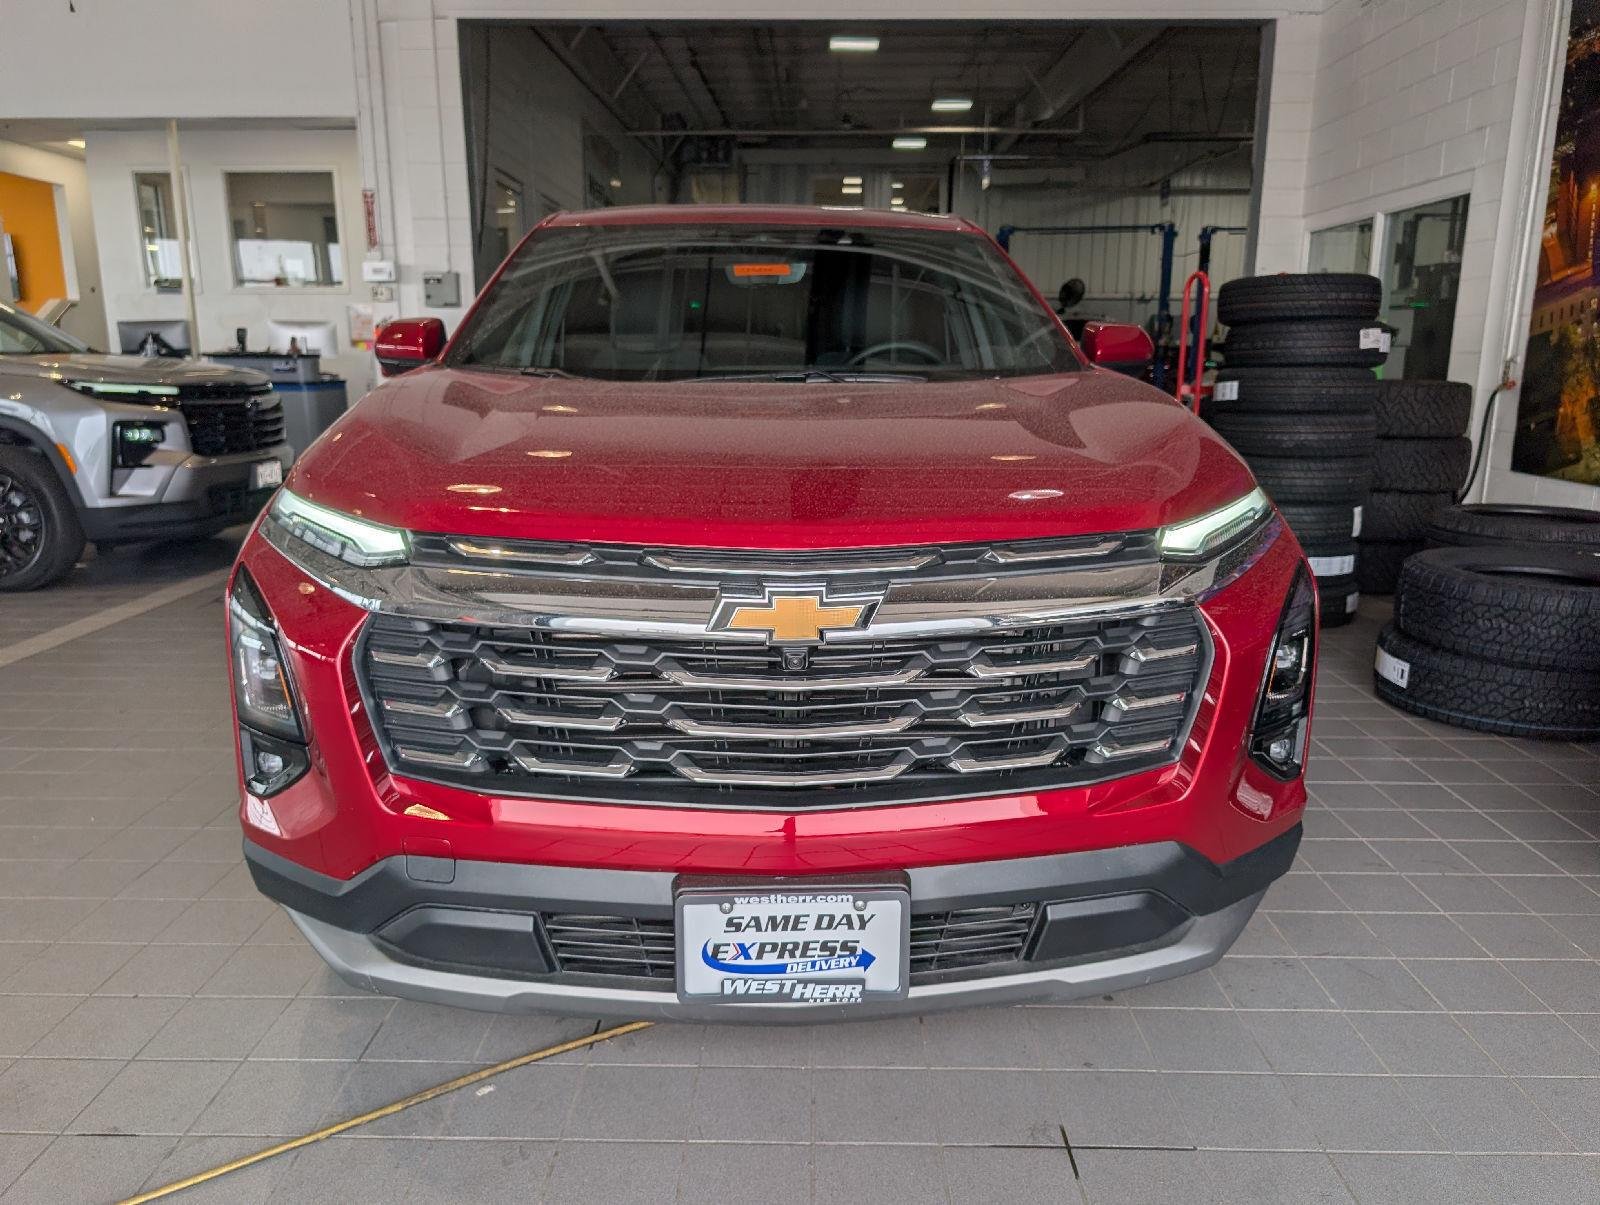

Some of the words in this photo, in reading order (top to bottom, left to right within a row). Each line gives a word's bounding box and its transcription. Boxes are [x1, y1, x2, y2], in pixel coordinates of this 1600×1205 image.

[734, 894, 854, 905] westherr.com
[723, 914, 810, 933] SAME
[813, 913, 877, 931] DAY
[710, 939, 860, 961] EXPRESS
[785, 955, 861, 974] DELIVERY
